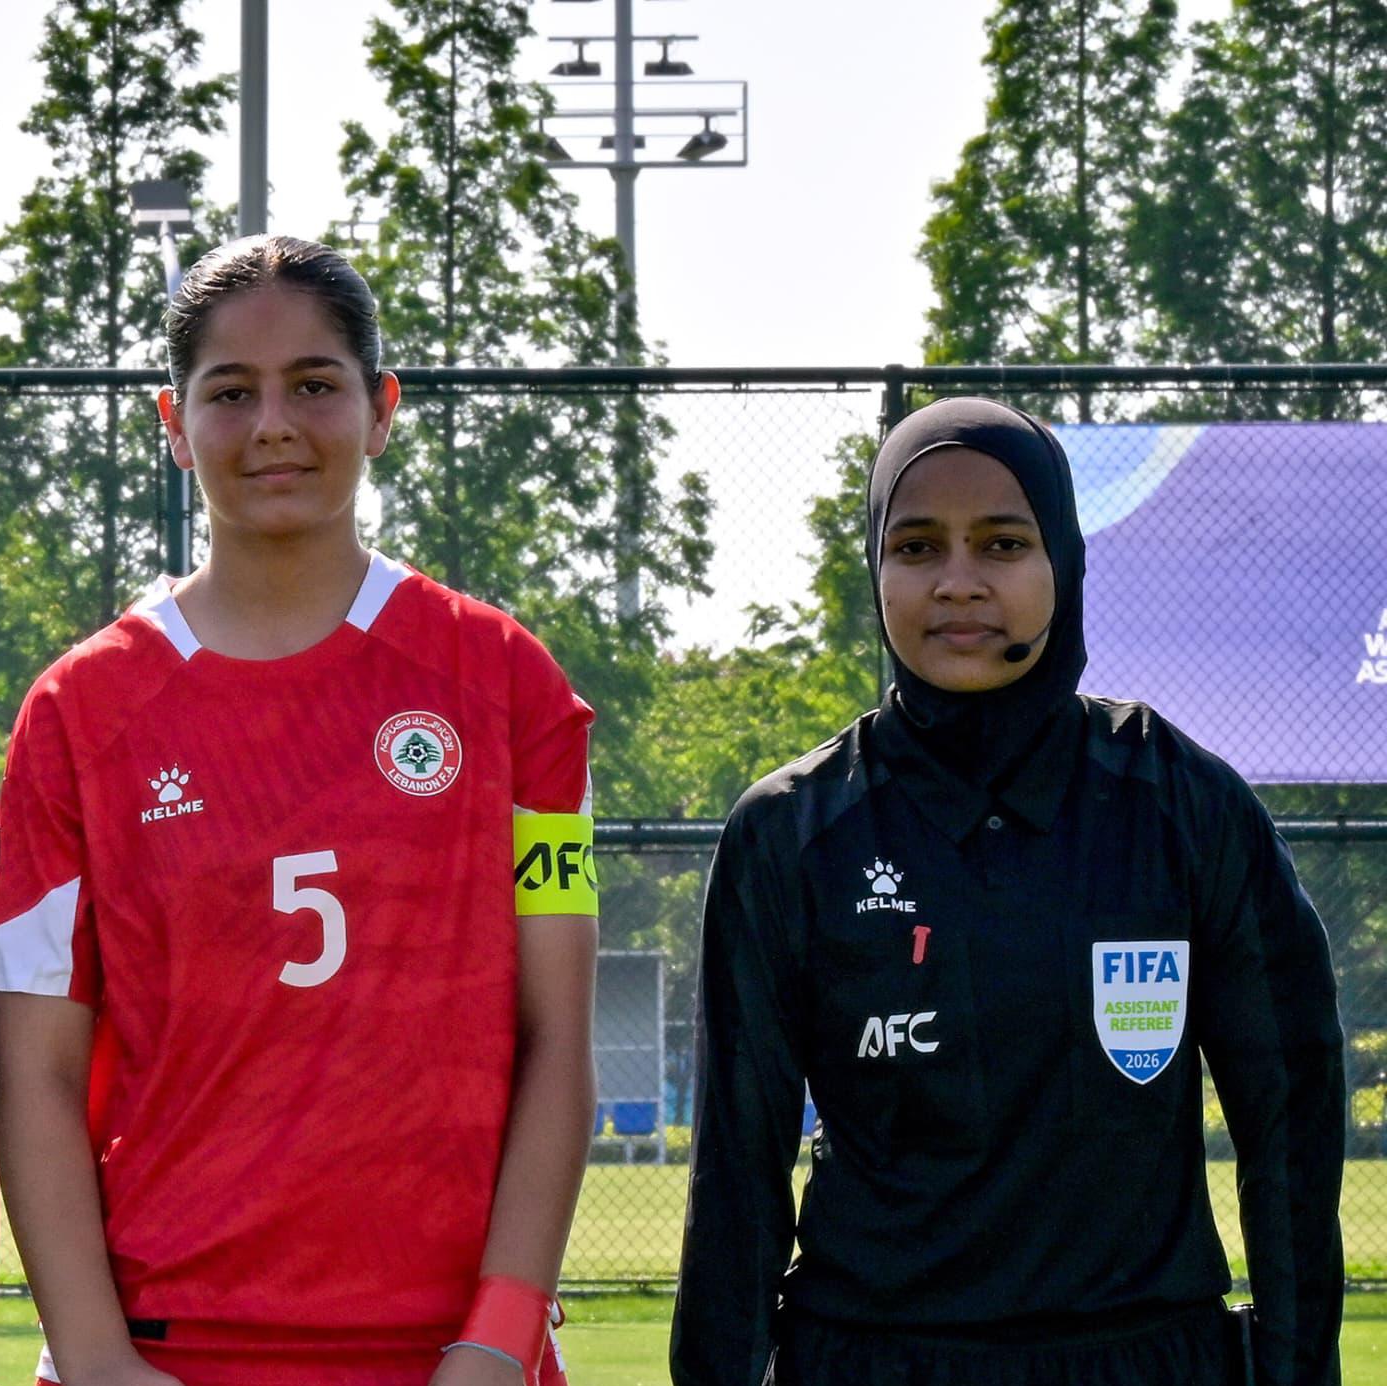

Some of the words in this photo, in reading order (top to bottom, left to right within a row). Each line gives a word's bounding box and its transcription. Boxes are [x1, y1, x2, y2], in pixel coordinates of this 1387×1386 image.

[388, 768, 441, 791] LEBANON
[140, 798, 204, 824] KELME
[856, 897, 917, 914] KELME
[272, 849, 347, 988] 5
[1102, 951, 1180, 984] FIFA
[1104, 999, 1180, 1016] ASSISTANT
[857, 1011, 940, 1058] AFC
[1110, 1015, 1173, 1031] REFEREE
[1125, 1052, 1160, 1069] 2026
